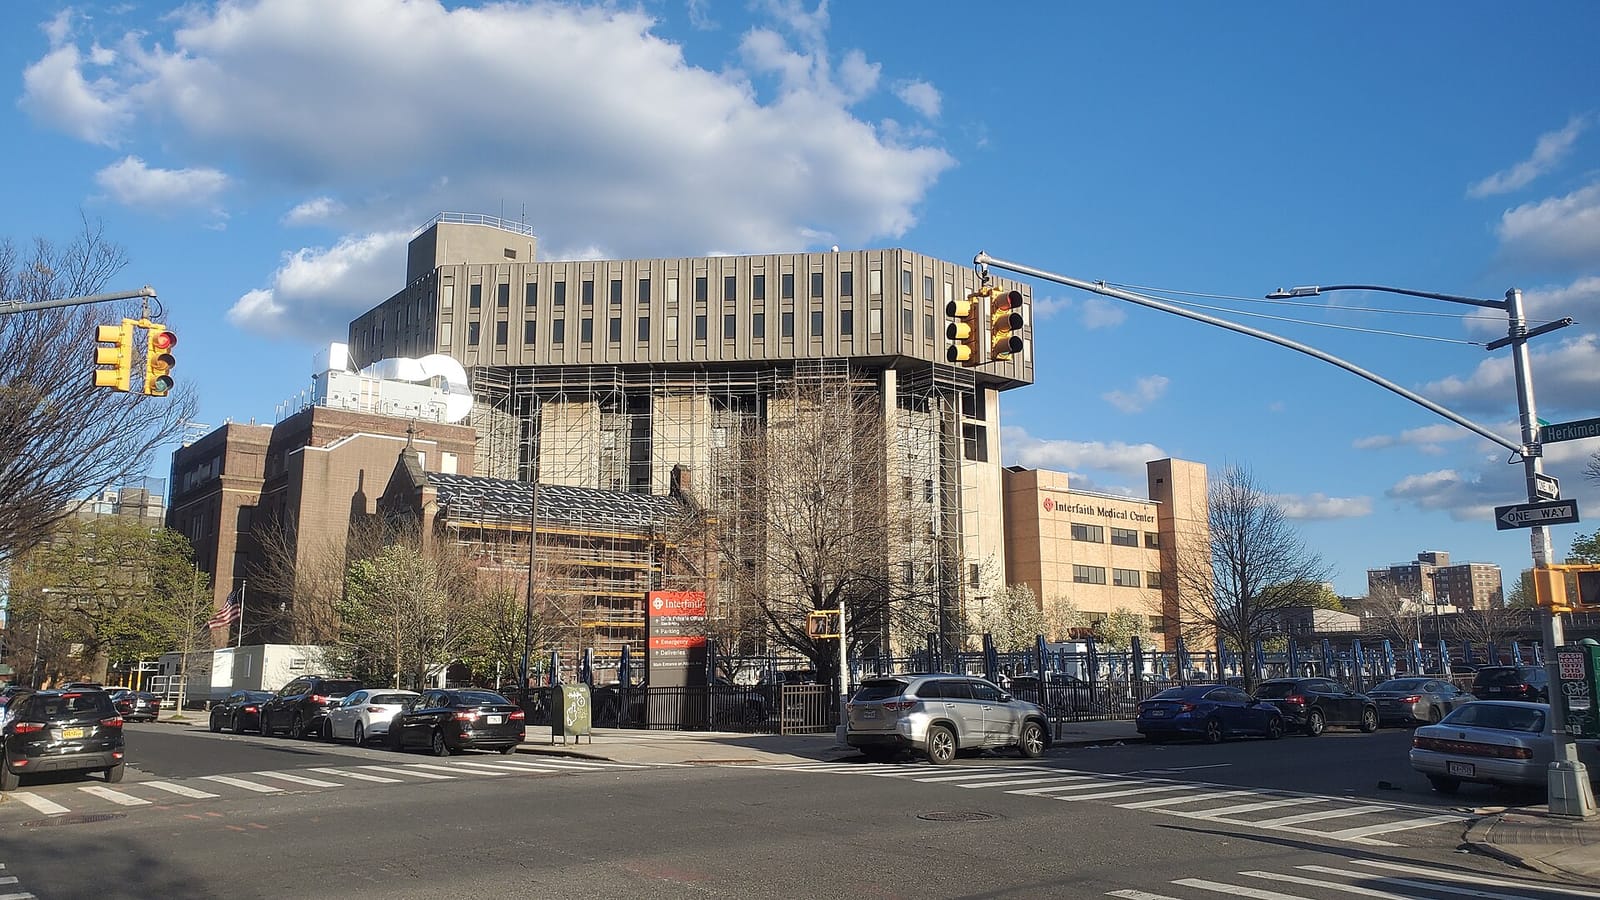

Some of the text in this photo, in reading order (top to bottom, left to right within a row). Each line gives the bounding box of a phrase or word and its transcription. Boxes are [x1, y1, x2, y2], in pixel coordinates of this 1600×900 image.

[1548, 424, 1600, 441] Herkimer
[1055, 501, 1155, 523] Interfaith Medical Center
[1508, 507, 1567, 521] ONE WAY
